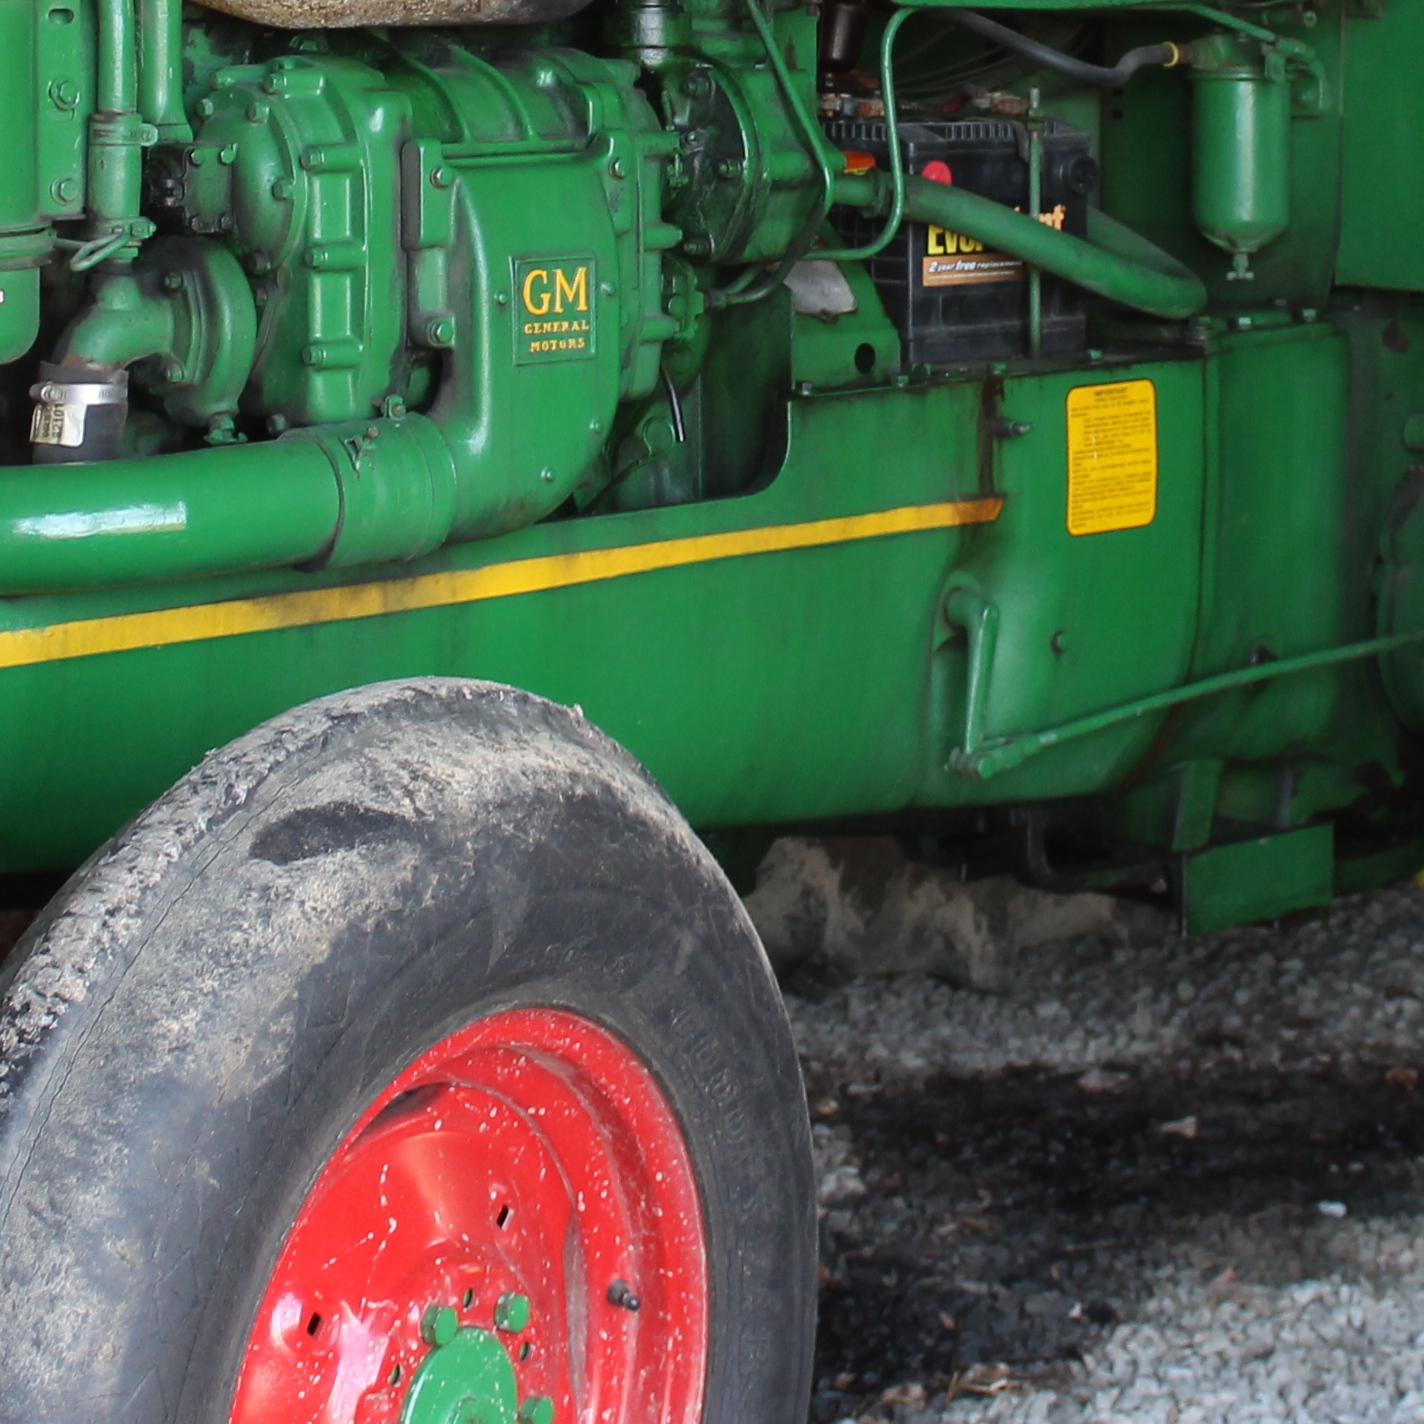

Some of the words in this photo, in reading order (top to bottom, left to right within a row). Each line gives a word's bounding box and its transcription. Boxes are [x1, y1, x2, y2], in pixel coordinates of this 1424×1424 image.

[928, 261, 938, 273] 2
[937, 262, 958, 272] year
[955, 259, 976, 271] free
[523, 266, 589, 316] GM
[524, 319, 590, 335] GENERAL
[530, 337, 586, 353] MOTORS
